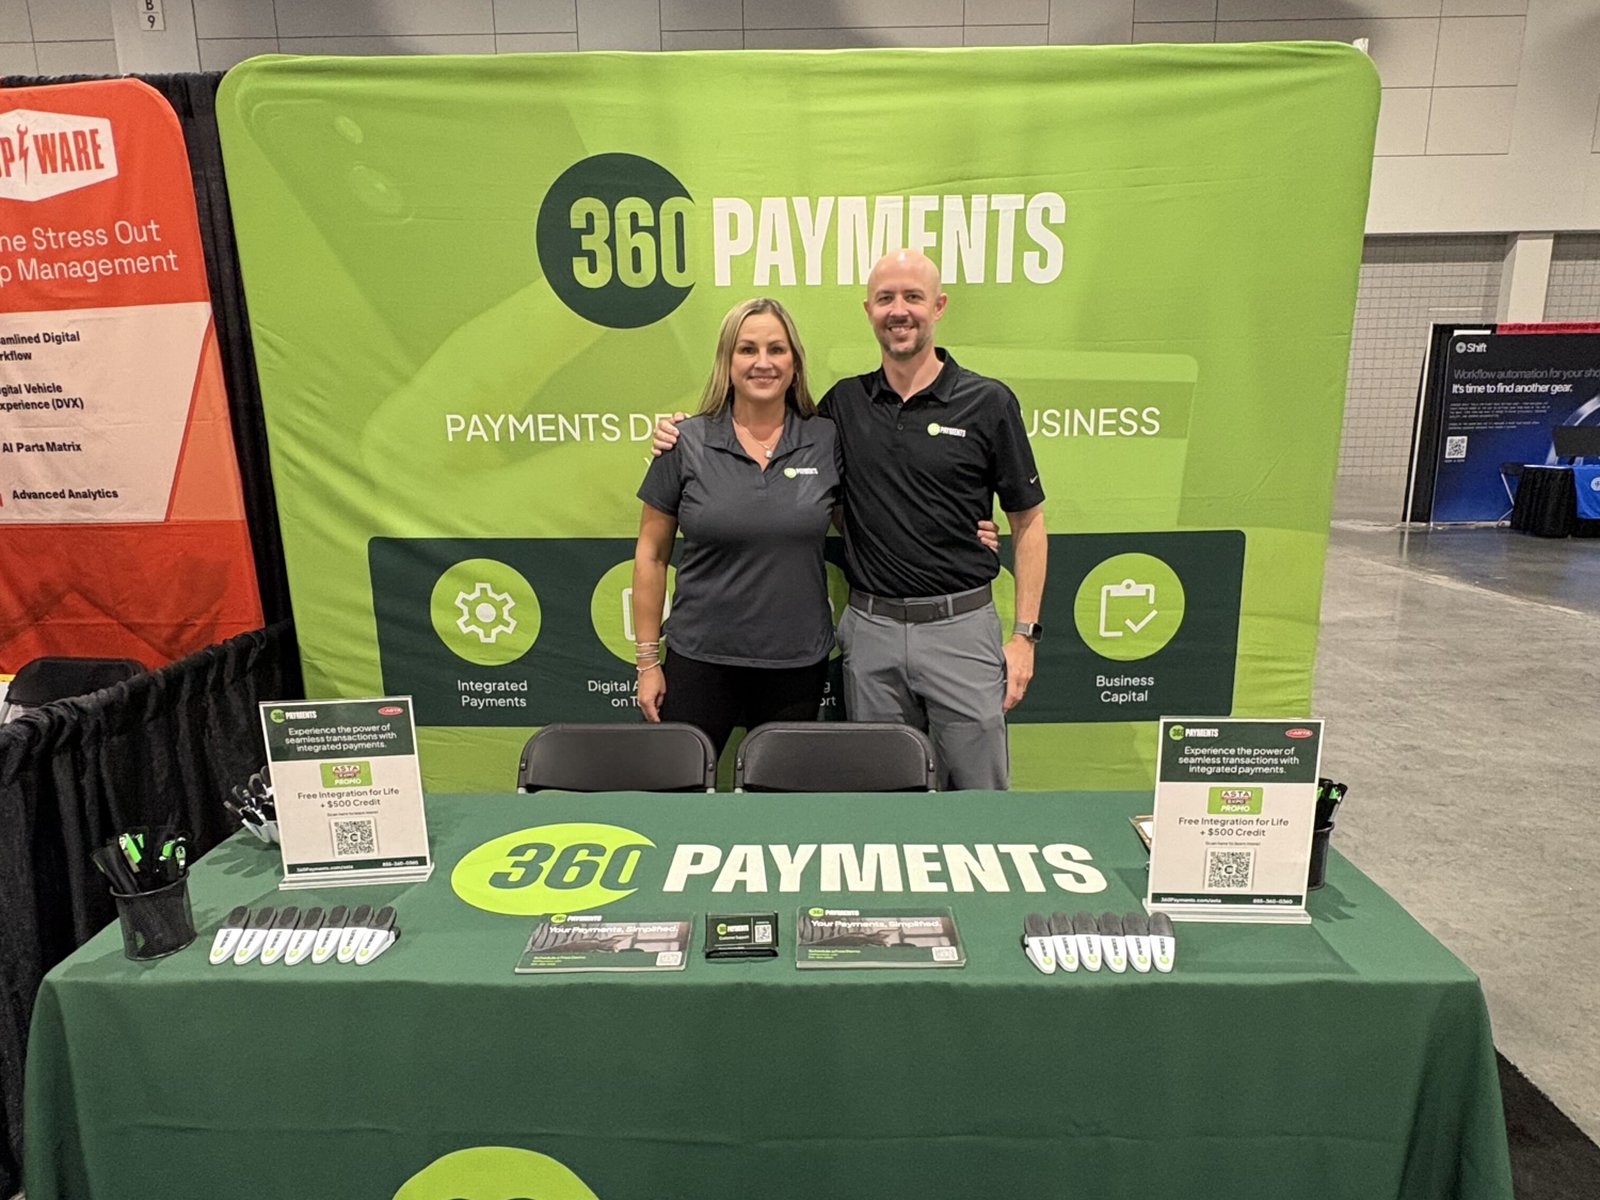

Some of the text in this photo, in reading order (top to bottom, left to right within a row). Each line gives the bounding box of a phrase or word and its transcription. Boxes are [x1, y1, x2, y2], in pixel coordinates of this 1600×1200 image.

[144, 0, 154, 10] B
[147, 14, 155, 28] 9
[33, 128, 104, 175] WARE
[32, 227, 108, 250] Stress
[114, 219, 161, 244] Out
[569, 191, 1066, 289] 360 PAYMENTS
[17, 249, 178, 282] Management
[0, 331, 80, 345] amlined Digital
[1466, 342, 1487, 353] Shift
[1454, 369, 1496, 380] Workflow
[1497, 368, 1548, 379] automation
[1549, 367, 1562, 378] for
[1562, 369, 1583, 380] your
[0, 382, 63, 397] gital Vehicle
[1452, 382, 1573, 395] It's time to find another gear.
[52, 397, 84, 411] (DVX)
[445, 413, 621, 442] PAYMENTS
[2, 441, 82, 453] AI Parts Matrix
[12, 488, 119, 501] Advanced Analytics
[457, 680, 528, 694] Integrated
[587, 680, 631, 695] Digital
[1096, 674, 1155, 688] Business
[461, 695, 527, 709] Payments
[611, 698, 629, 708] on
[1100, 689, 1149, 705] Capital
[288, 723, 391, 736] Experience the power of
[1185, 728, 1219, 738] PAYMENTS
[285, 731, 397, 745] seamless transactions with
[296, 740, 387, 752] integrated payments.
[1184, 746, 1295, 757] Experience the power of
[1178, 755, 1300, 765] seamless transactions with
[1188, 765, 1287, 776] integrated payments.
[297, 787, 400, 800] Free Integration for Life
[327, 799, 352, 809] $500
[353, 798, 381, 808] Credit
[1178, 816, 1289, 828] Free Integration for Life
[1207, 828, 1234, 837] $500
[1235, 828, 1266, 837] Credit
[485, 842, 1107, 894] 360 PAYMENTS
[549, 926, 571, 934] Your
